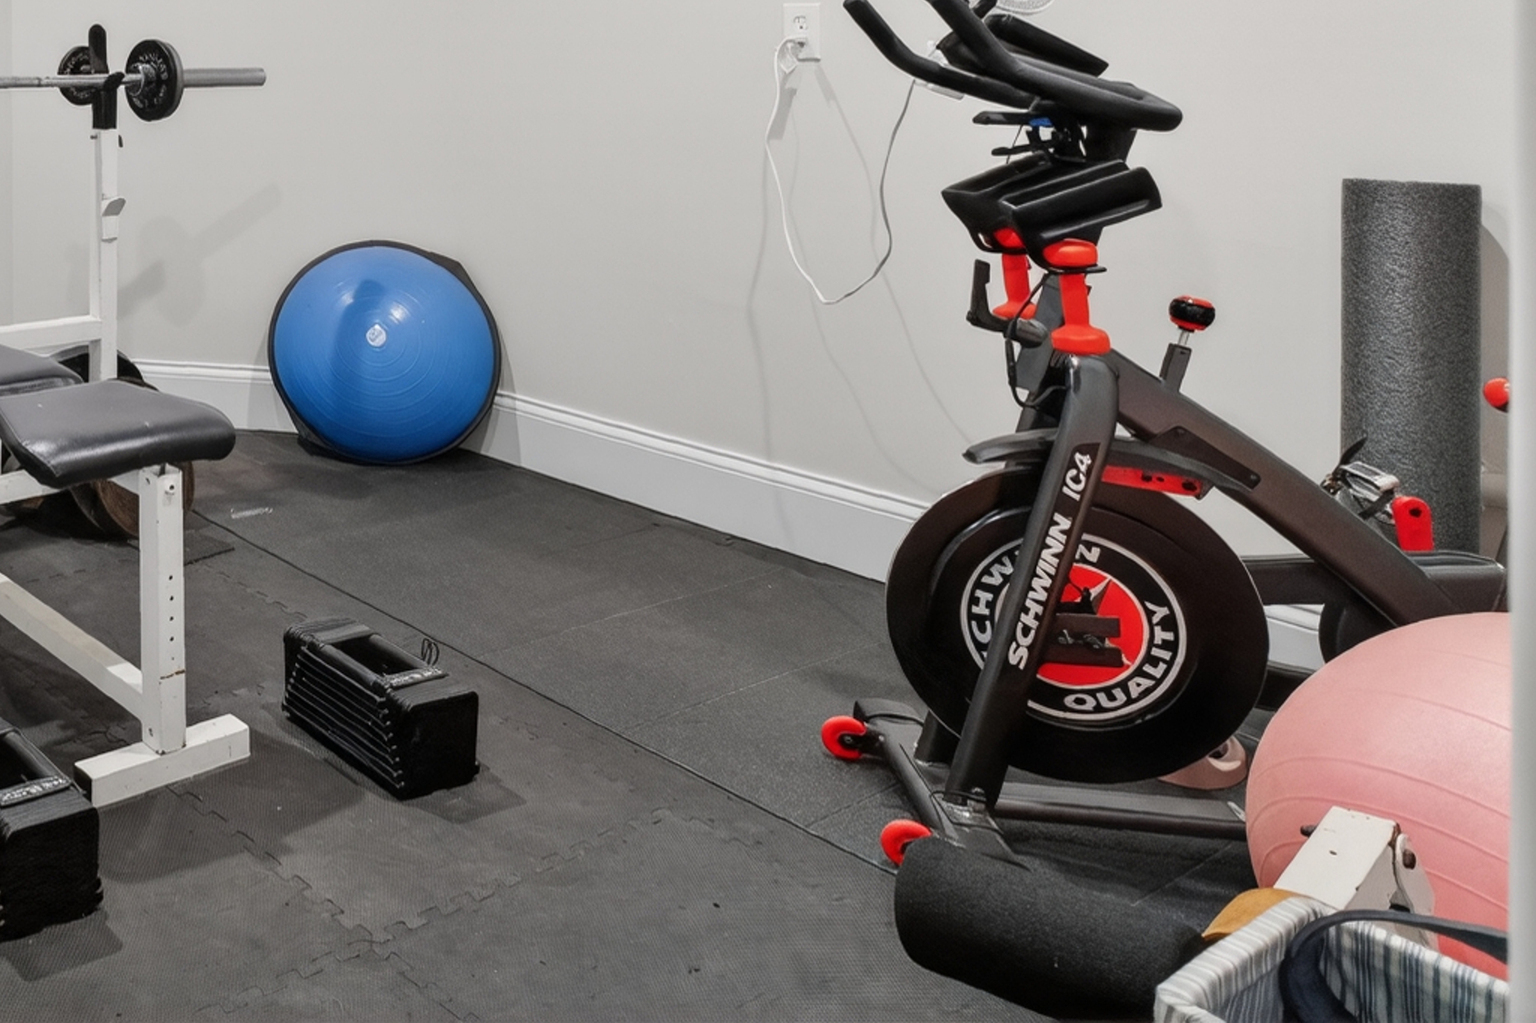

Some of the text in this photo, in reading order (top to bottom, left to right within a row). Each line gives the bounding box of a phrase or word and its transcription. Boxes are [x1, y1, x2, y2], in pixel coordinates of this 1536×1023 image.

[971, 543, 1101, 664] CHWN
[1009, 451, 1092, 669] SCHWINN IC4
[1064, 601, 1175, 711] QUALITY
